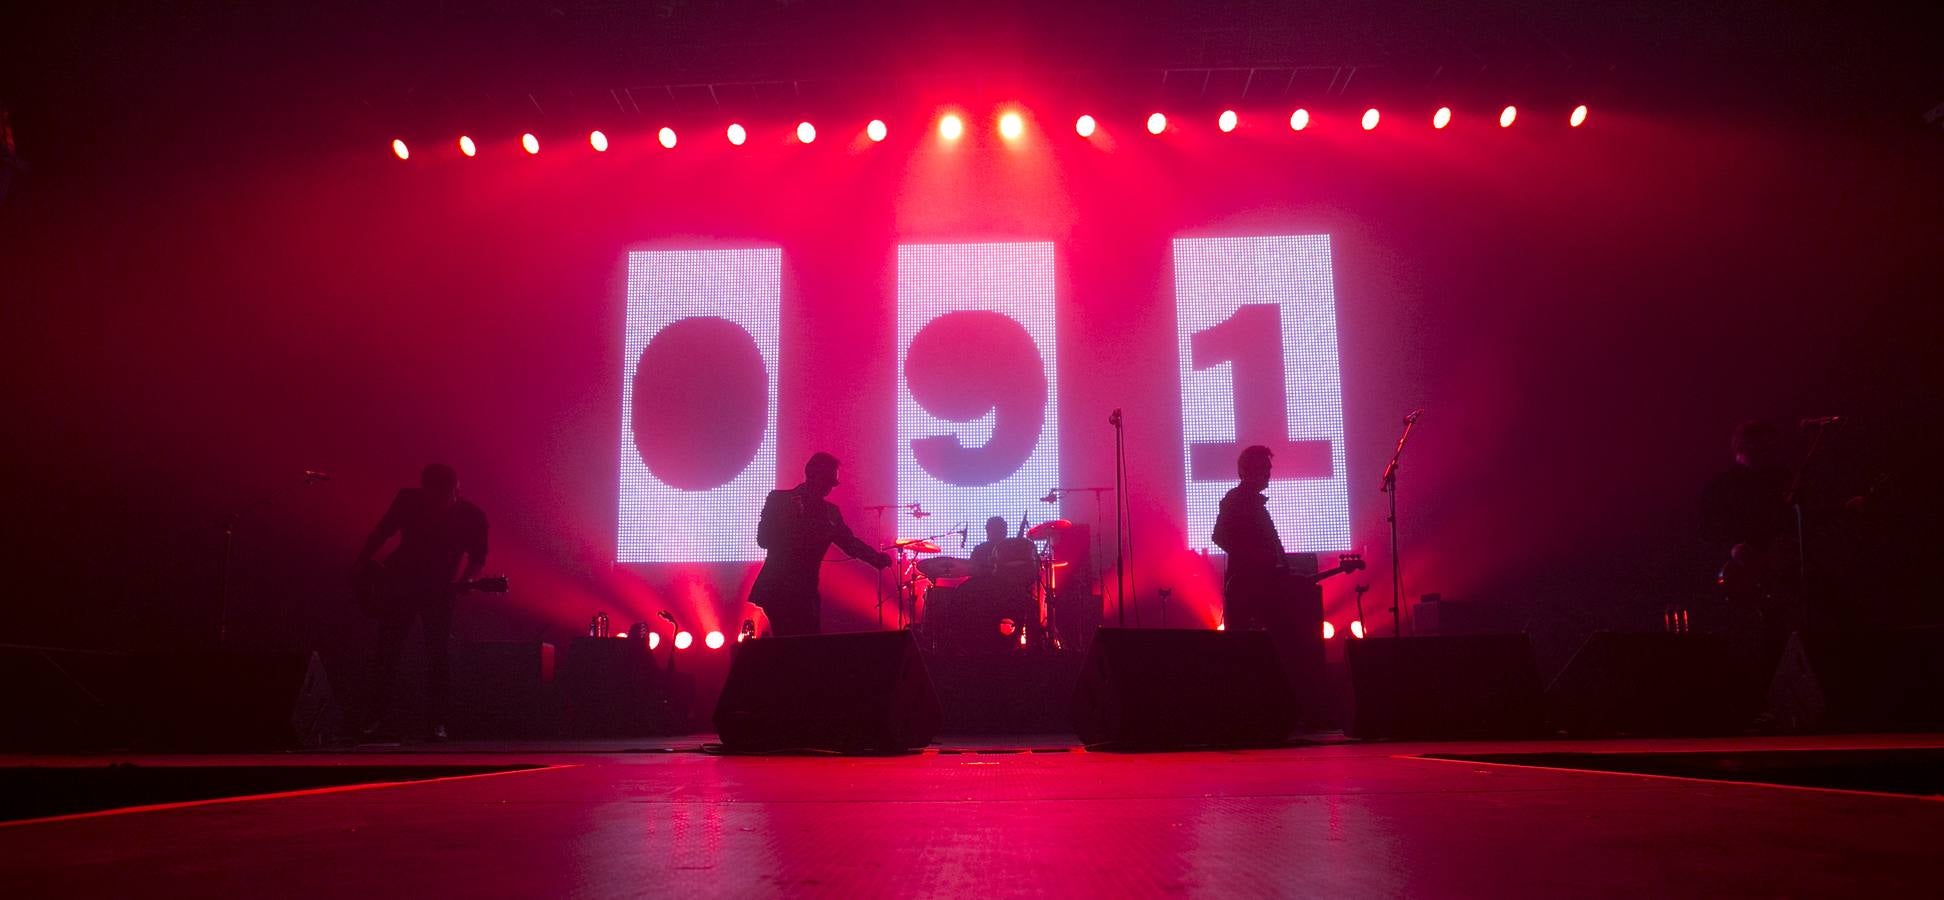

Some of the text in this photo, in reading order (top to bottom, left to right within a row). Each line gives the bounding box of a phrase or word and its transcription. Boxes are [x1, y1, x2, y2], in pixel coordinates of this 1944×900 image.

[631, 303, 1333, 491] 0 9 1
